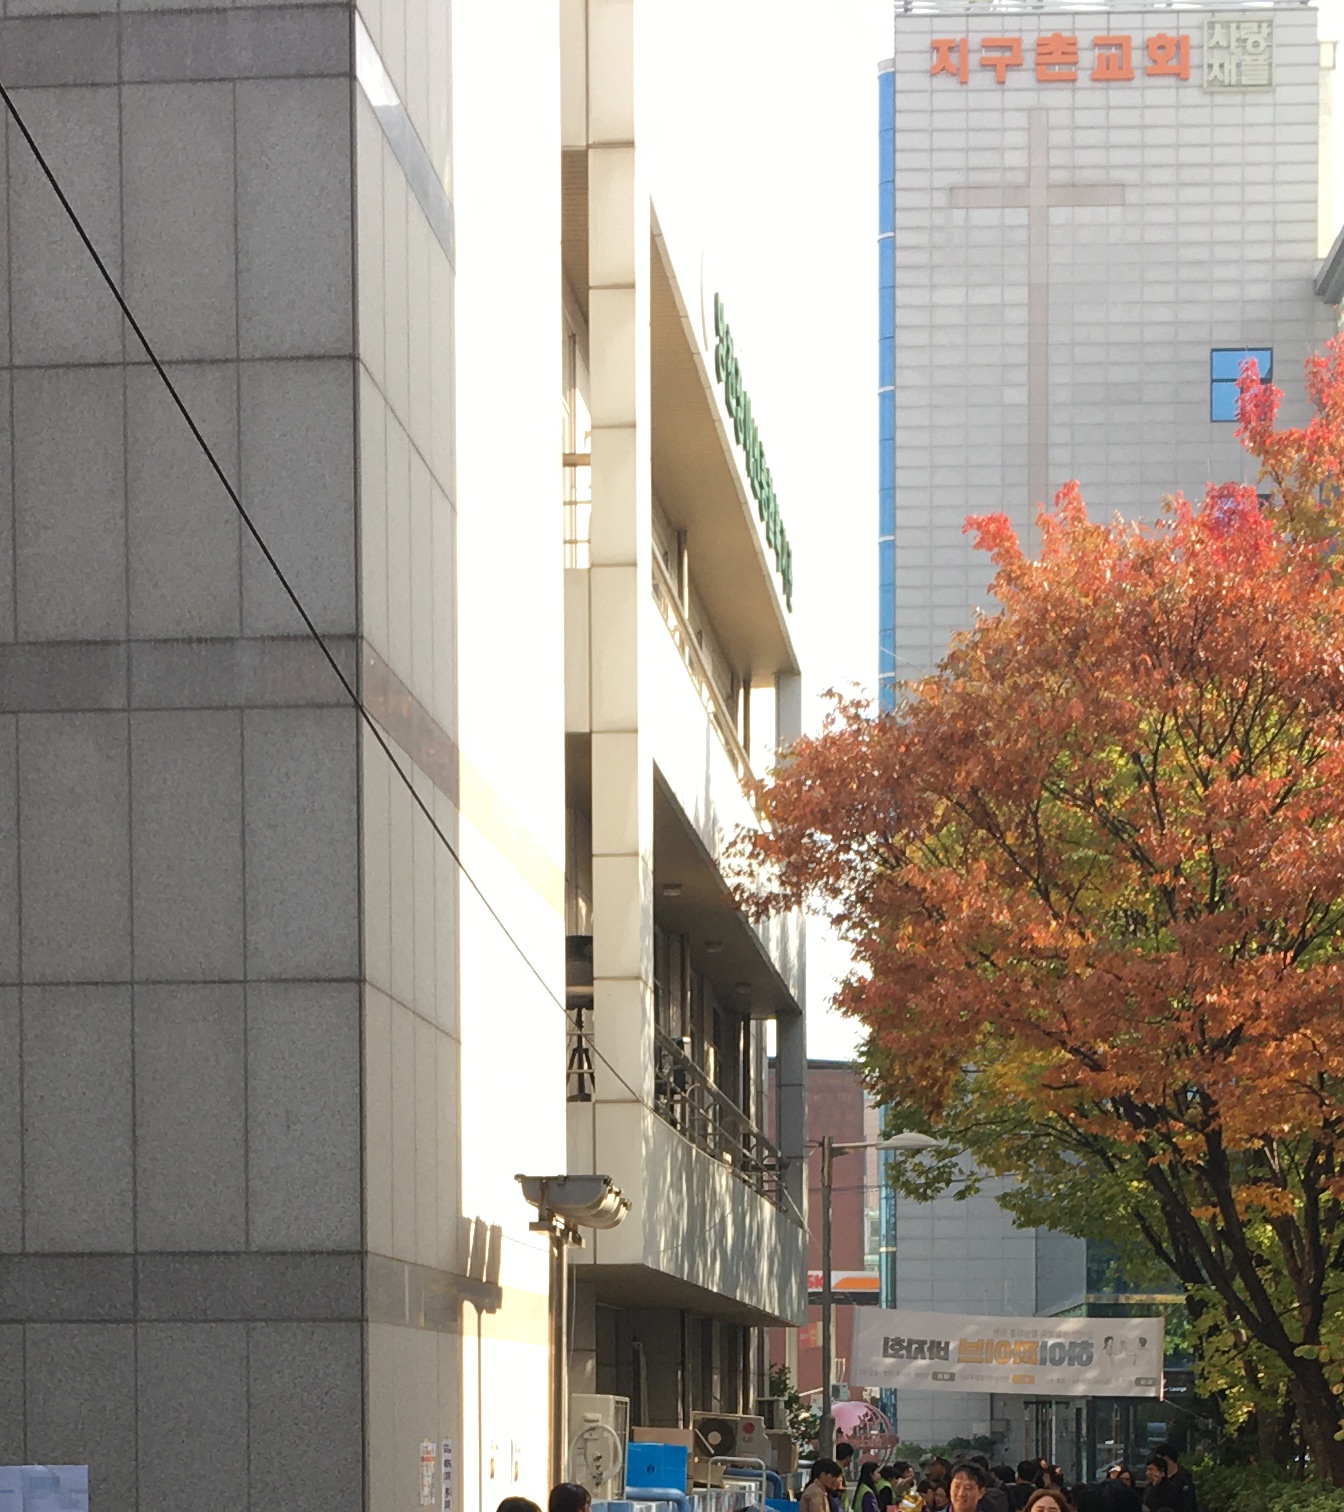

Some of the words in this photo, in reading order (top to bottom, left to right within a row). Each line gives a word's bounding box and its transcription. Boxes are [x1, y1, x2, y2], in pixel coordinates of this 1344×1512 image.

[1208, 22, 1272, 54] 사랑
[931, 33, 1191, 83] 지구촌교회
[1208, 54, 1272, 86] 채플
